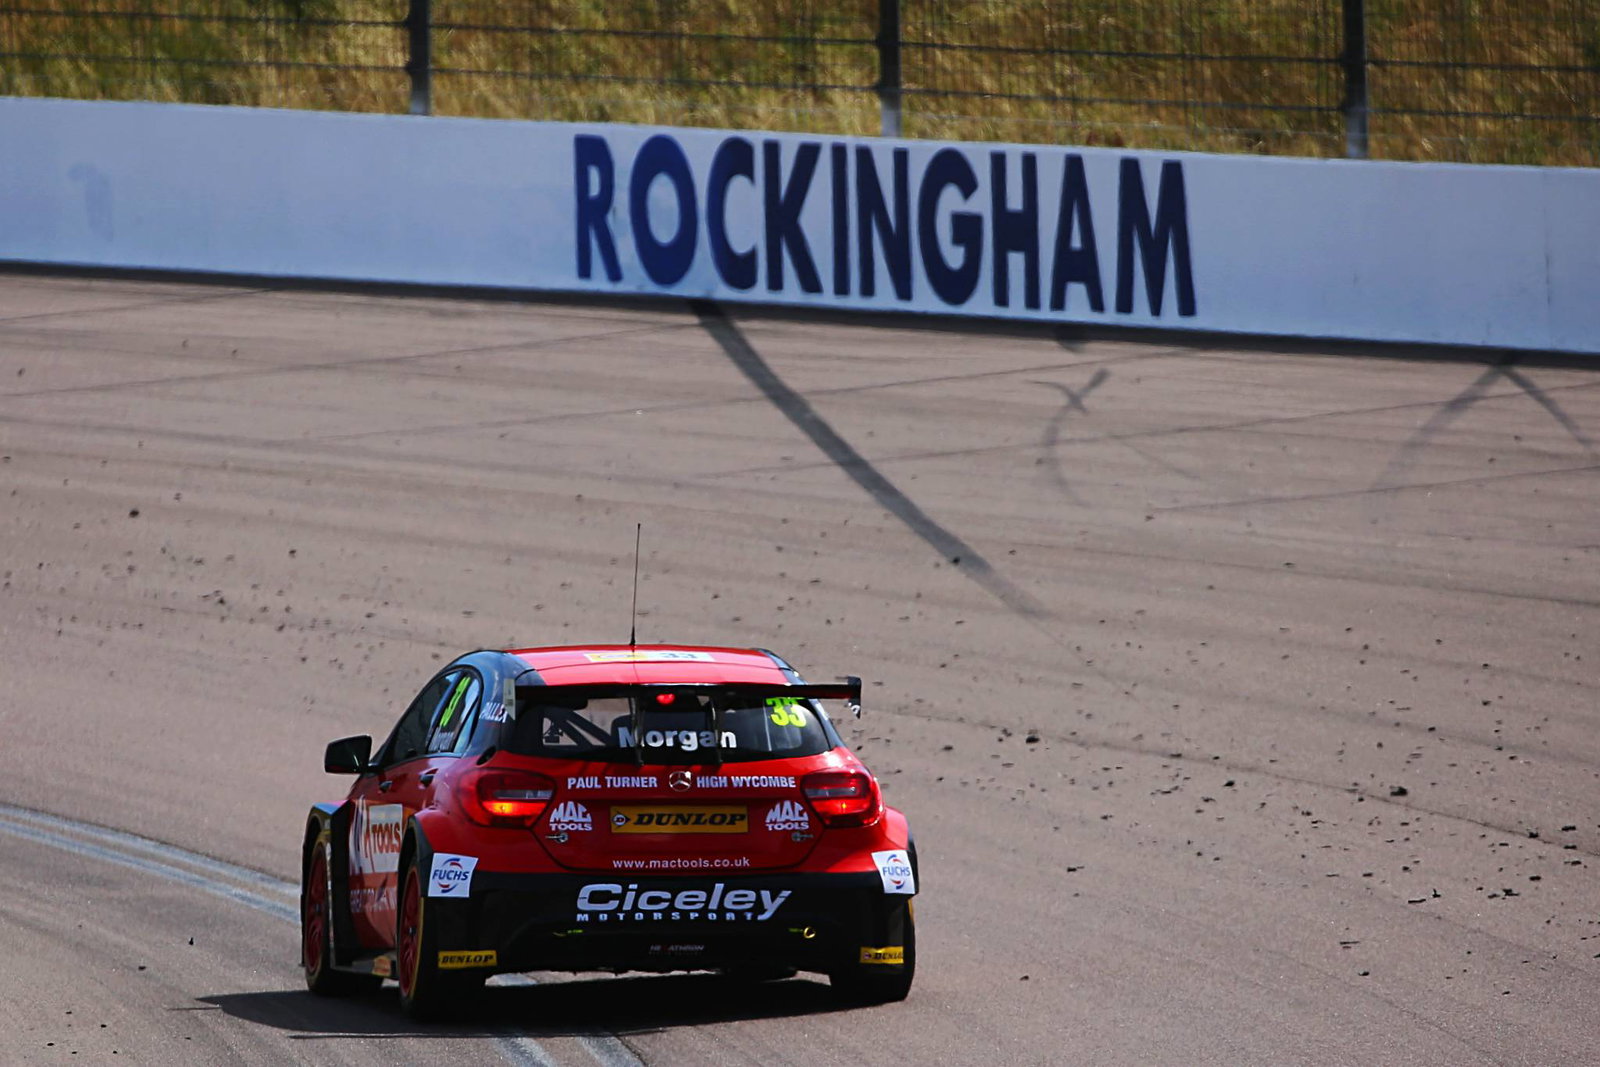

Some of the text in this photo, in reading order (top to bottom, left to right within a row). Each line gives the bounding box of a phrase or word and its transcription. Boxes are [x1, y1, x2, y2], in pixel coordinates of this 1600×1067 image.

[574, 133, 1196, 317] ROCKINGHAM
[766, 697, 807, 728] 33
[618, 727, 737, 751] Morgan
[566, 777, 658, 789] PAUL TURNER
[696, 776, 796, 789] HIGH WYCOMBE
[549, 801, 592, 822] MAC
[766, 801, 809, 822] MAC
[633, 813, 746, 825] DUNLOP
[549, 823, 593, 832] TOOLS
[765, 822, 809, 831] TOOLS
[371, 822, 401, 854] TOOLS
[612, 857, 751, 870] www.mactools.co.uk
[432, 869, 470, 881] FUCHS
[882, 866, 911, 877] FUCHS
[577, 883, 792, 920] Ciceley
[576, 912, 754, 922] MOTORSPORT
[441, 953, 494, 964] DUNLOP
